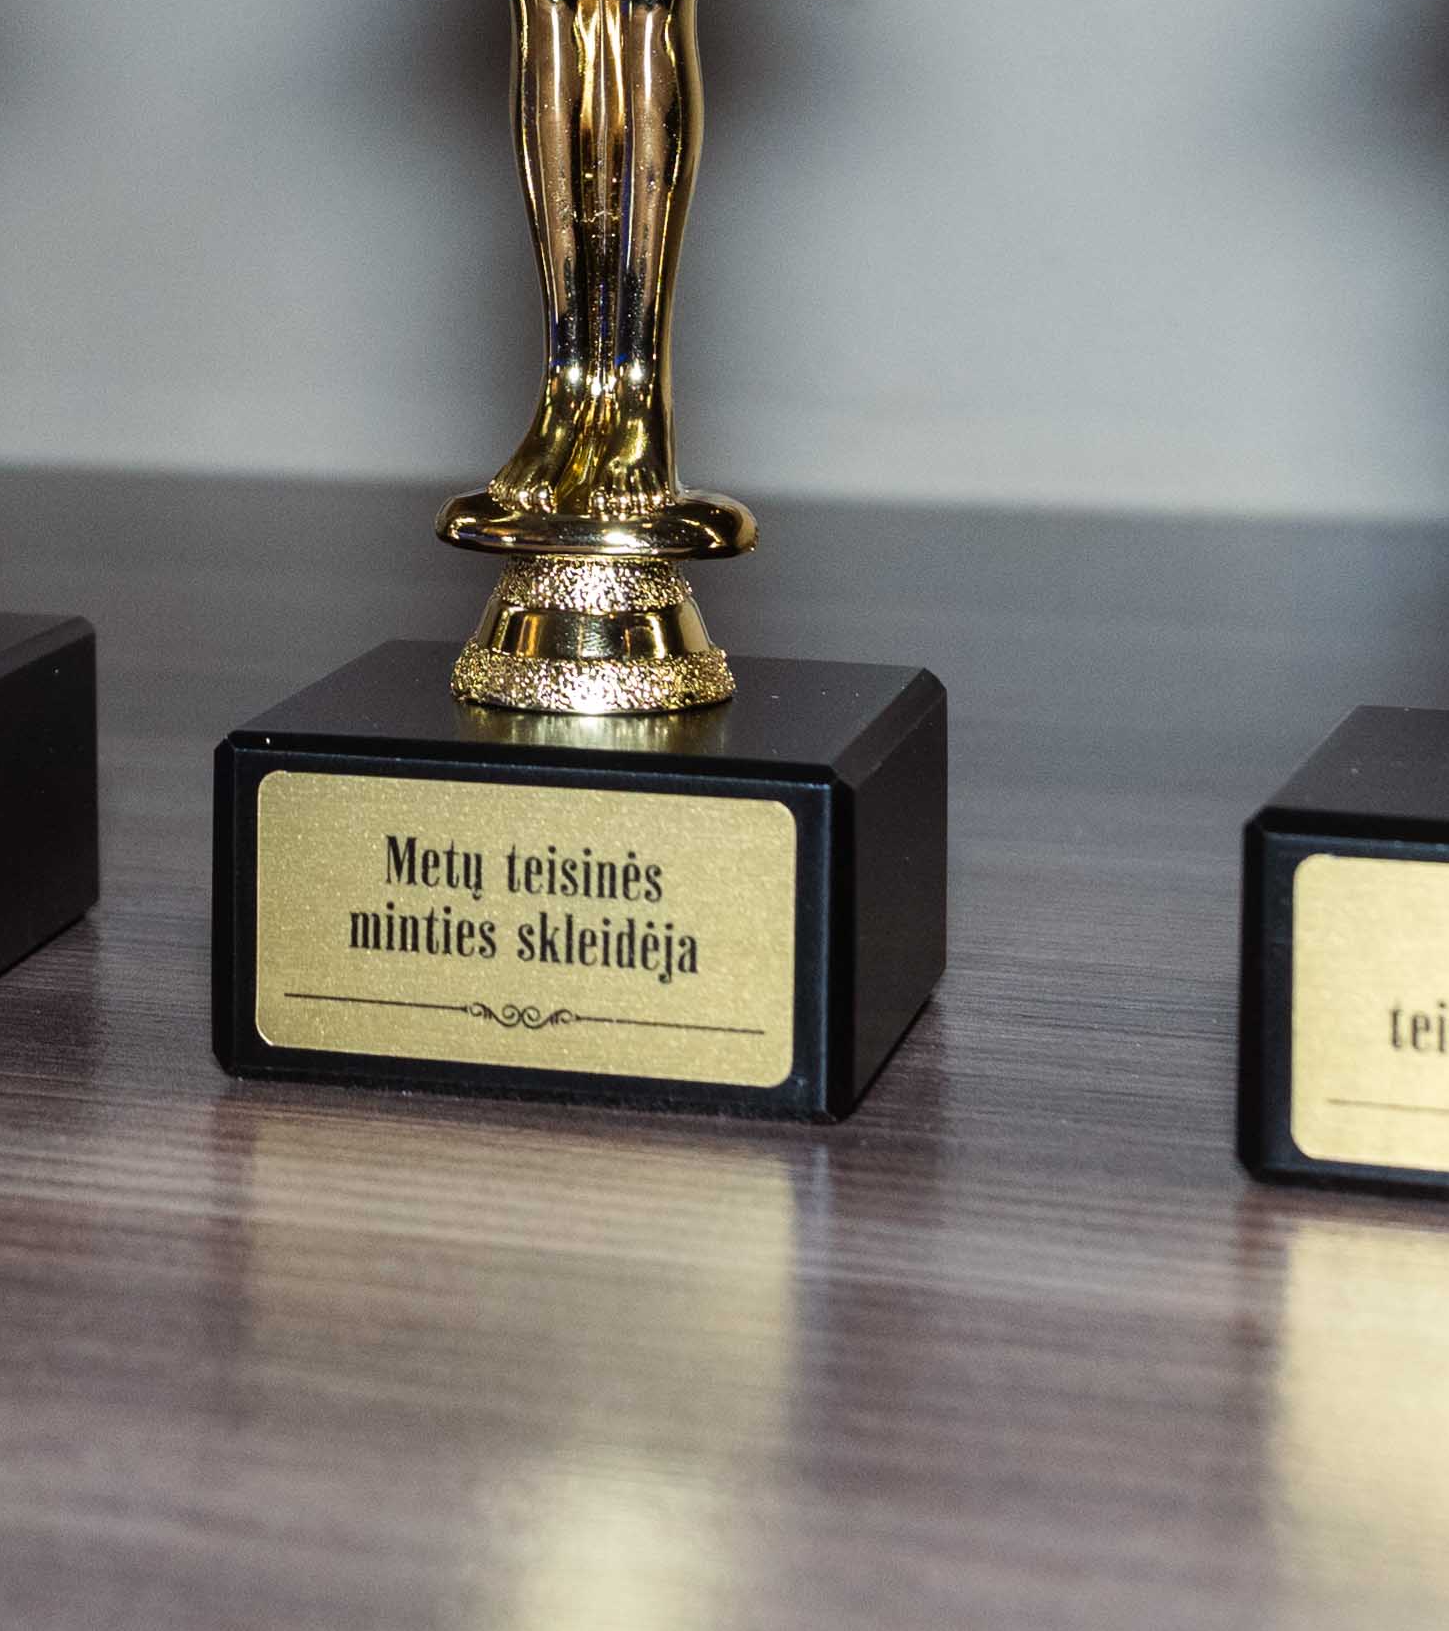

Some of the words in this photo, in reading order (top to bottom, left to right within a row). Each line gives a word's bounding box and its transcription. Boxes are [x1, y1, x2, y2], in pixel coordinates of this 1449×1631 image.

[386, 835, 483, 901] Metų
[507, 842, 662, 902] teisinės
[350, 902, 496, 959] minties
[517, 911, 698, 983] skleidėja
